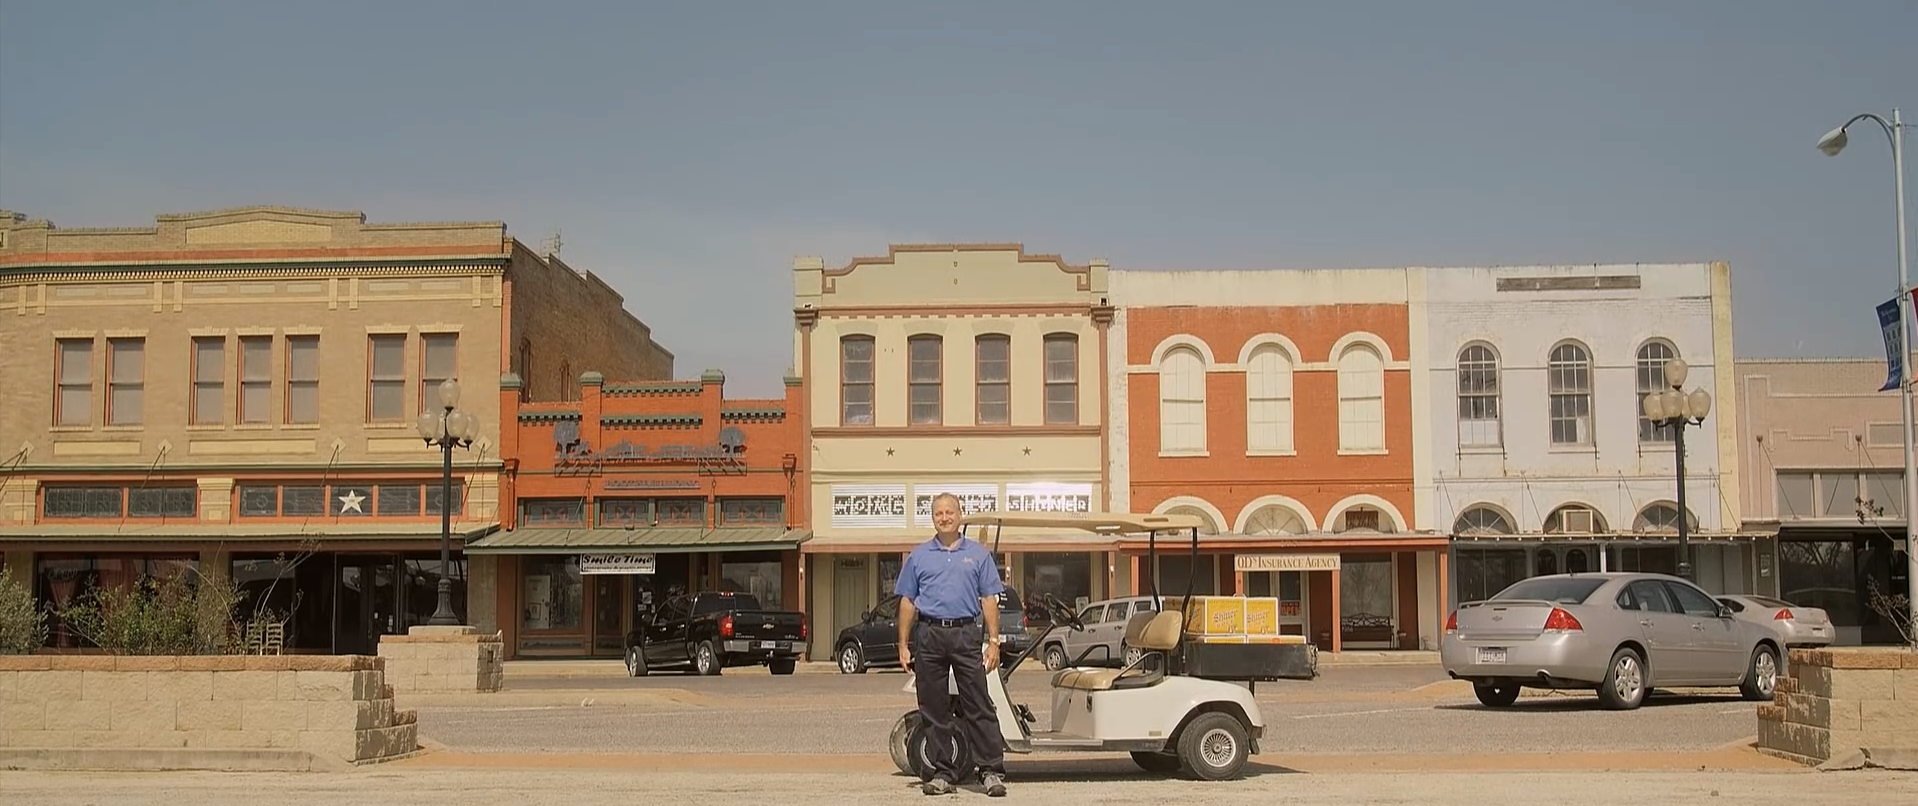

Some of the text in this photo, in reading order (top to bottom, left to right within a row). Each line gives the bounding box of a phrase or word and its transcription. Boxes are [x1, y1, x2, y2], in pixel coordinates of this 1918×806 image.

[833, 497, 904, 515] HOME
[1008, 496, 1088, 512] SHINER
[624, 555, 653, 564] Time
[1259, 556, 1304, 568] INSURANCE
[1304, 556, 1338, 568] AGENCY
[1213, 609, 1239, 622] Shiner
